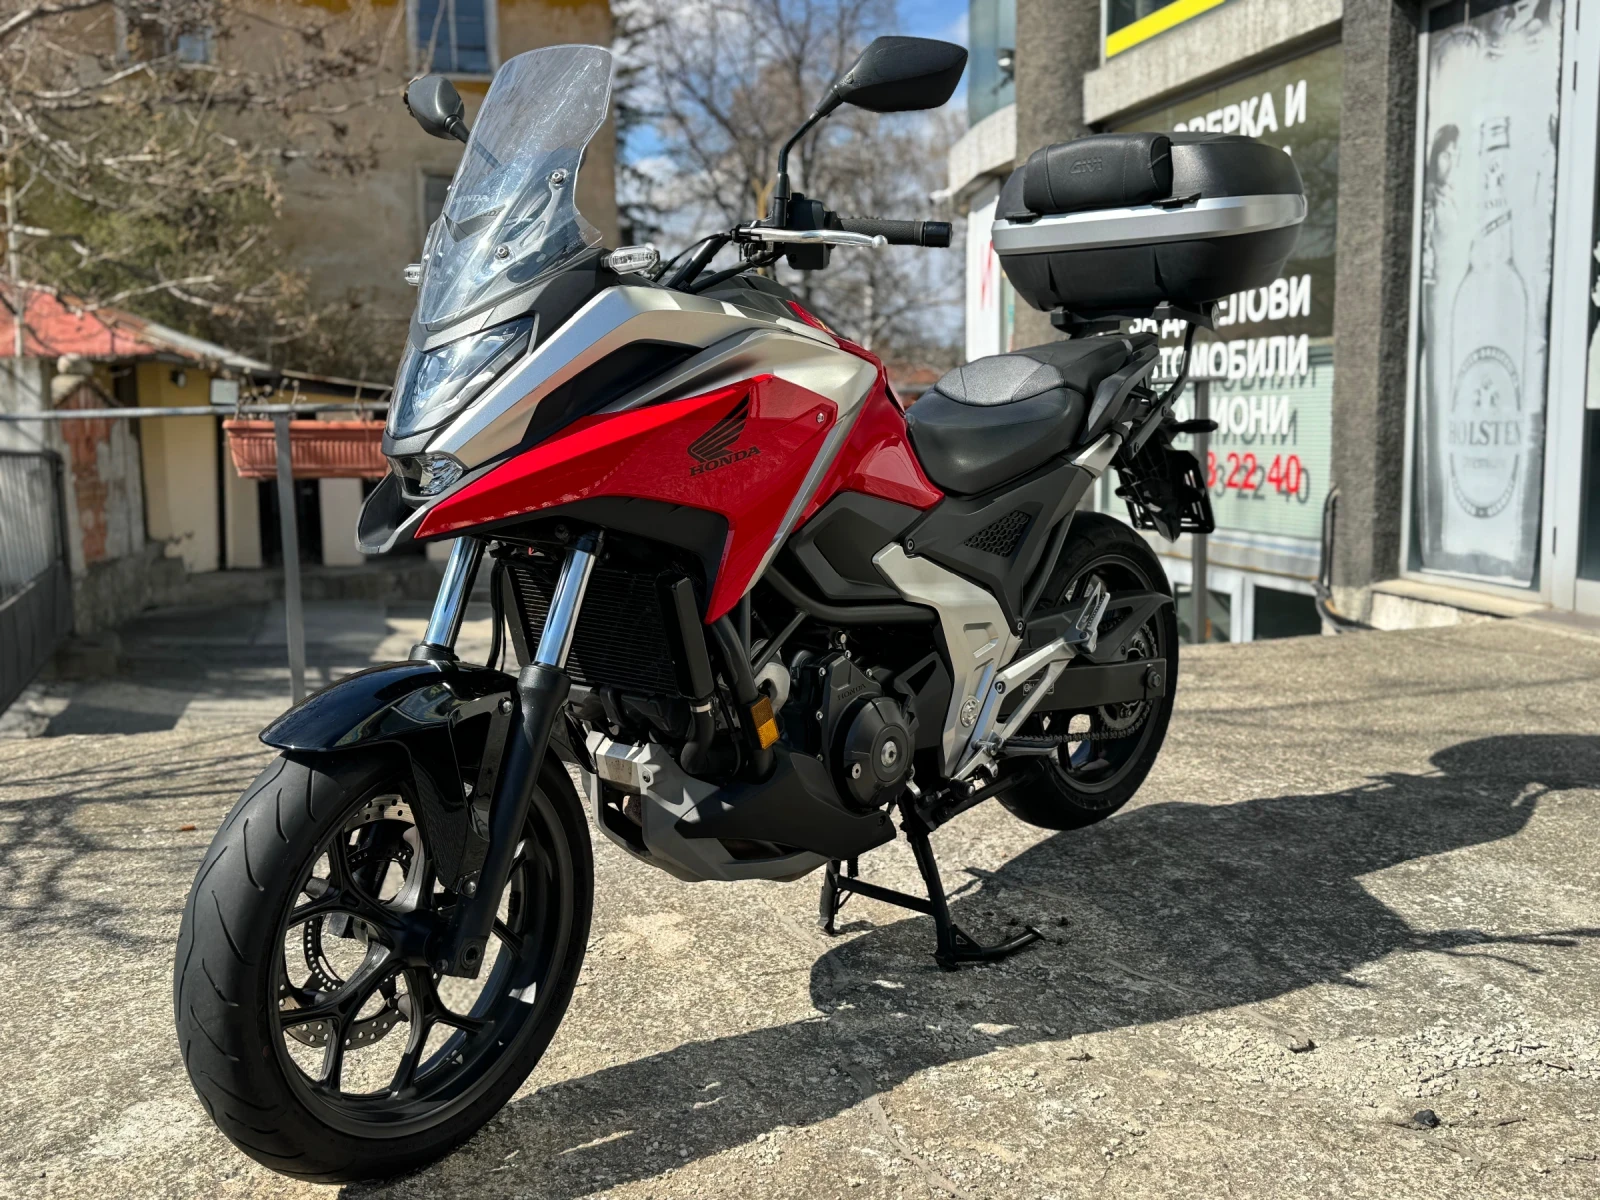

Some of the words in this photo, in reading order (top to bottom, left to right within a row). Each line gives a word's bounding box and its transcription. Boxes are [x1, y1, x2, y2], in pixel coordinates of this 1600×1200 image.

[1284, 79, 1307, 128] И
[1070, 157, 1103, 174] GIVI
[1151, 334, 1309, 380] ТОМОБИЛИ
[689, 445, 761, 476] HONDA
[1226, 452, 1257, 490] 22
[1267, 454, 1302, 493] 40
